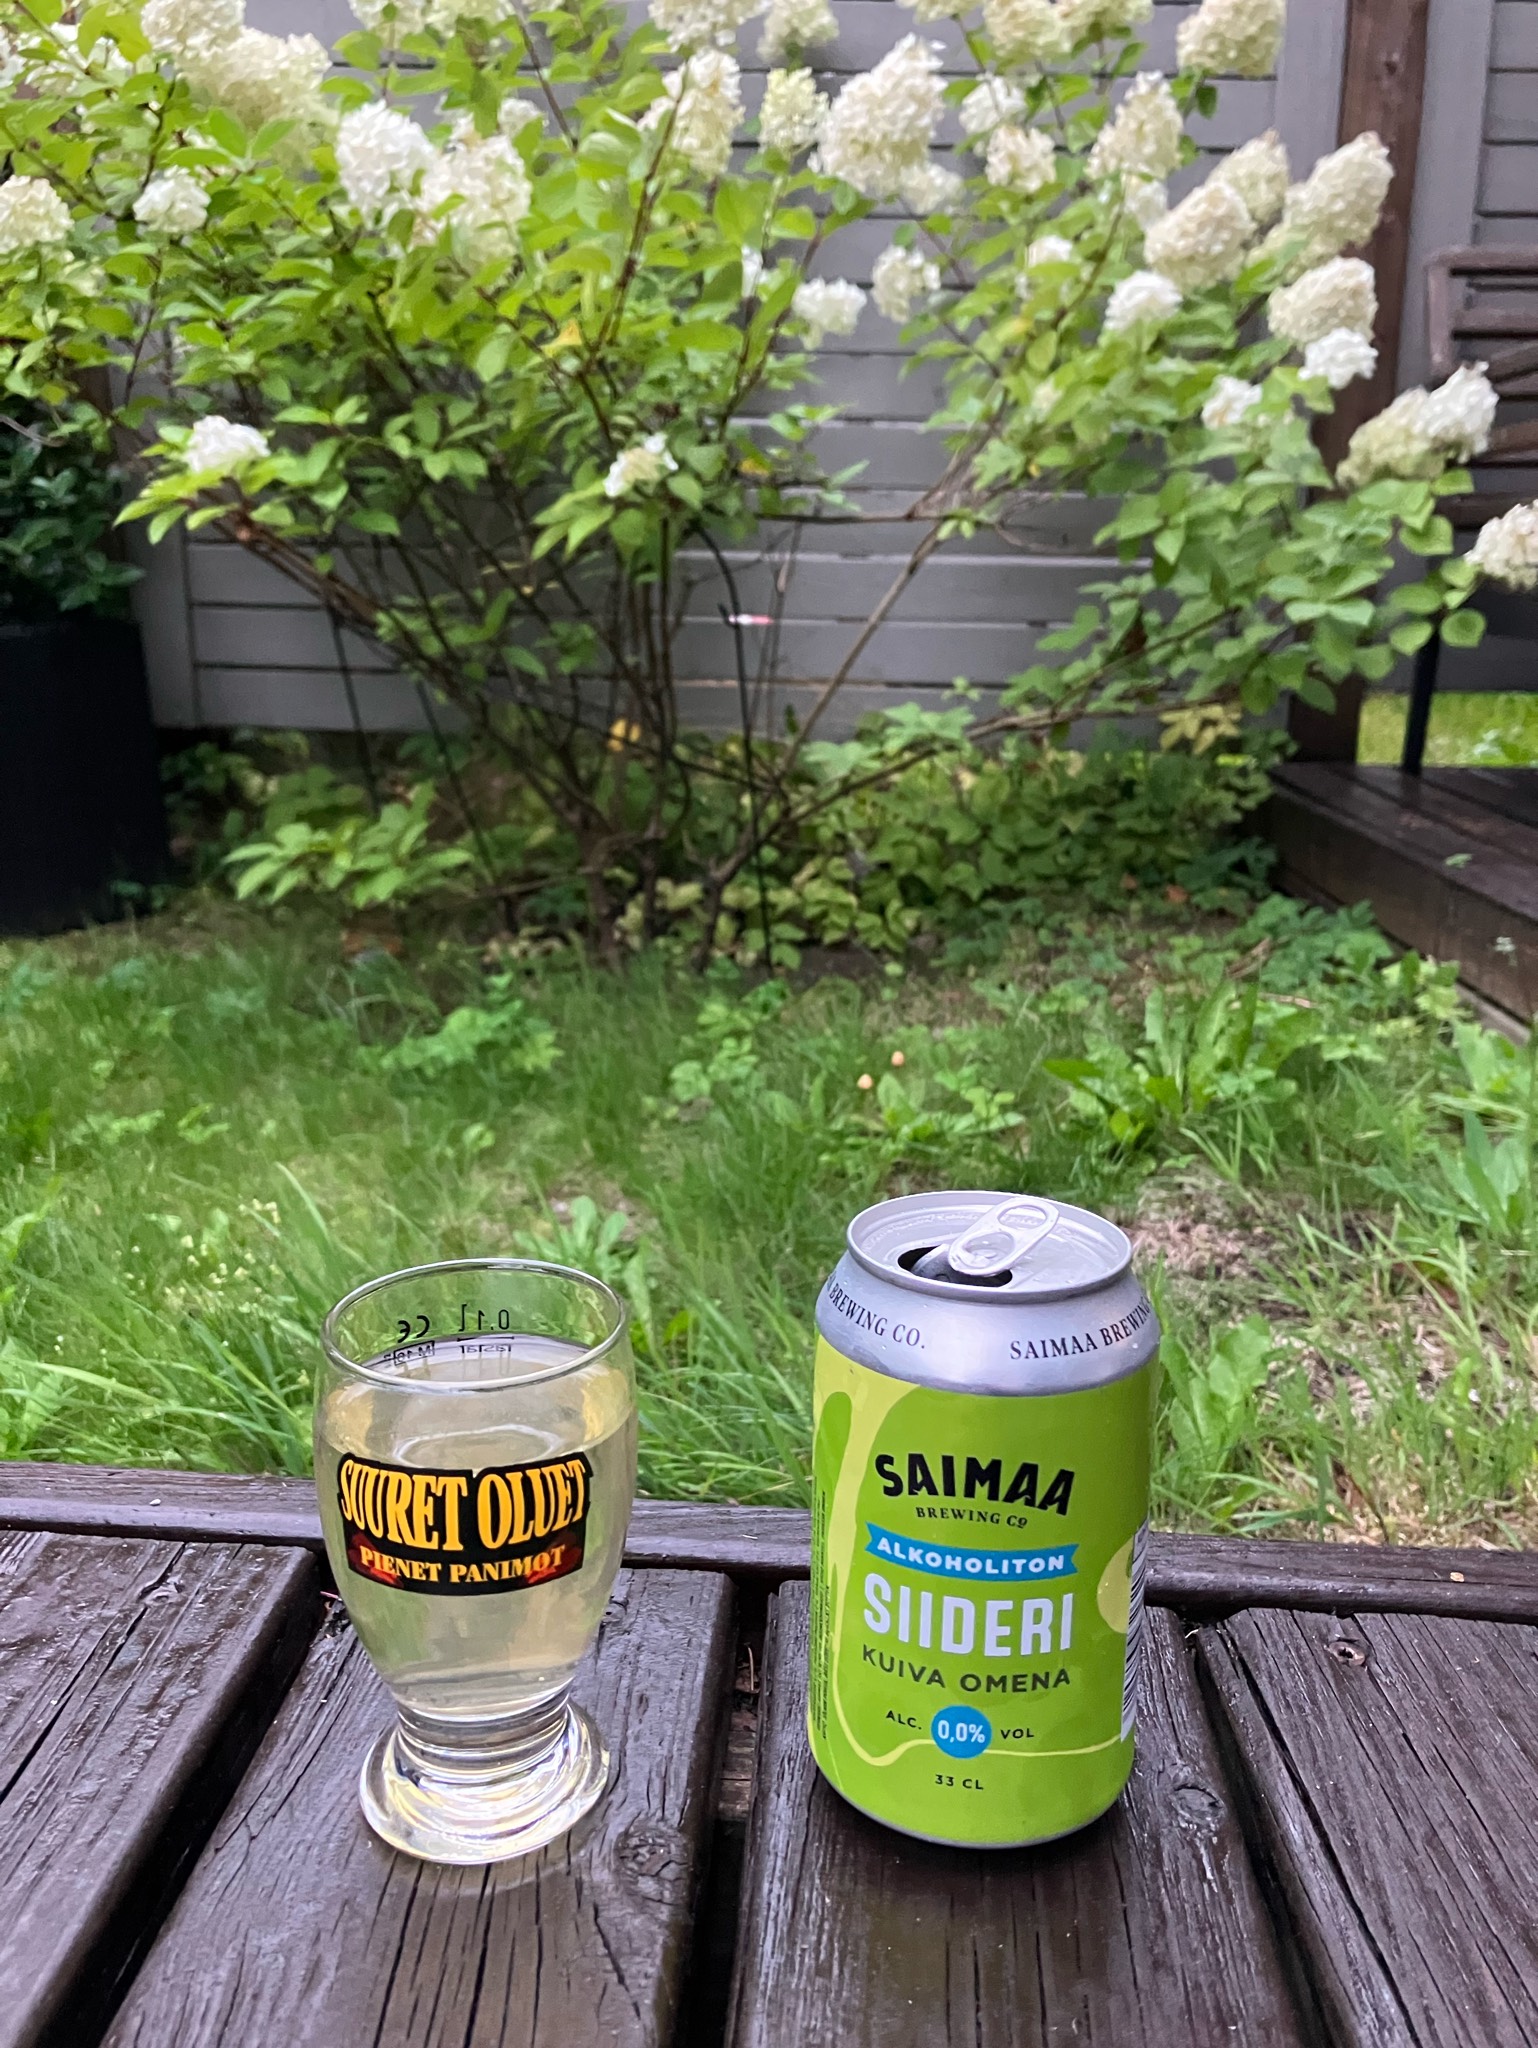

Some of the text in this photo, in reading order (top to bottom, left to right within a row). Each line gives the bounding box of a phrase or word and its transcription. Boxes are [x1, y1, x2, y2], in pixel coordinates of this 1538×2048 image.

[829, 1283, 925, 1349] BREWING CO.
[1010, 1332, 1099, 1360] SAIMAA
[874, 1453, 1075, 1516] SAIMAA
[340, 1459, 586, 1551] SUURET OLUET
[916, 1507, 1001, 1525] BREWING
[359, 1545, 566, 1583] PIENET PANIMOT
[877, 1536, 1064, 1574] ALKOHOLITON
[863, 1572, 1074, 1657] SIIDERI
[862, 1644, 1070, 1693] KUIVA OMENA
[886, 1710, 1035, 1743] ALC. 0,0% VOL
[935, 1773, 984, 1790] 33 CL
